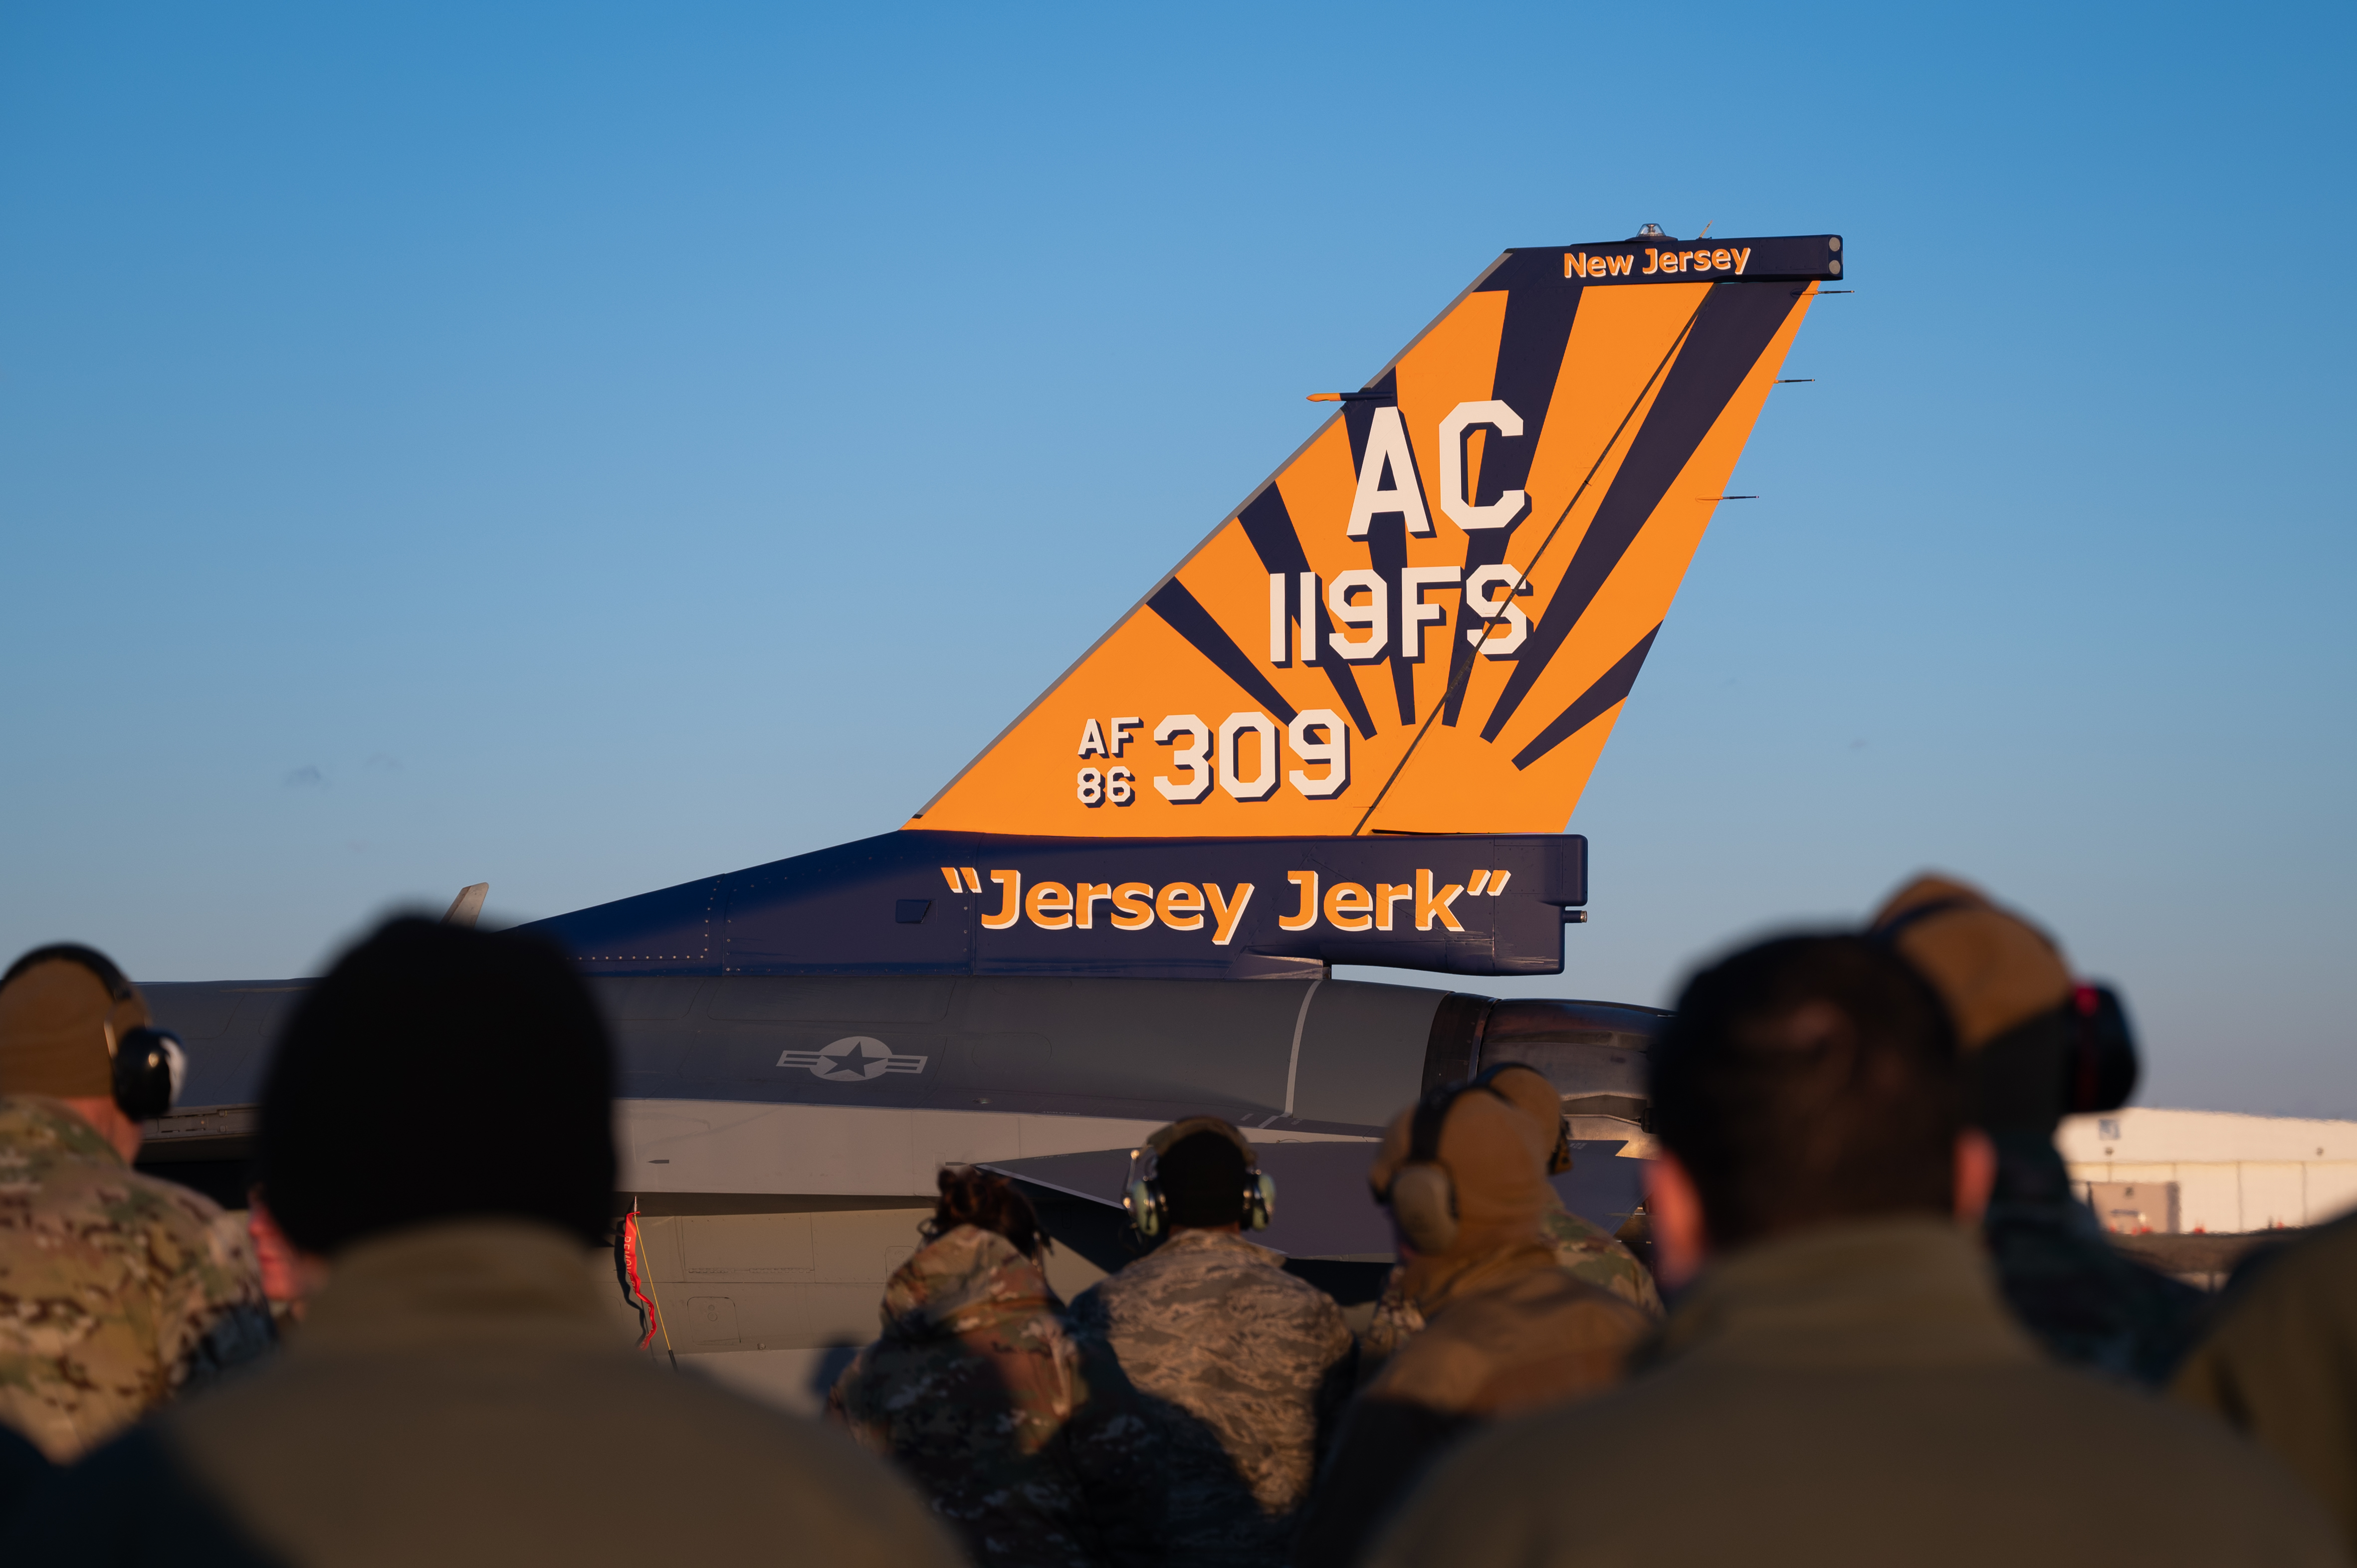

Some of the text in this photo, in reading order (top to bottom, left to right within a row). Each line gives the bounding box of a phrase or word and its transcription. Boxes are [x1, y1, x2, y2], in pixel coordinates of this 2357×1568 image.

[1564, 247, 1751, 278] New Jersey
[1346, 399, 1526, 537] AC
[1270, 564, 1529, 662] 119FS
[1077, 716, 1140, 756] AF
[1153, 709, 1347, 801] 309
[1077, 767, 1131, 804] 86
